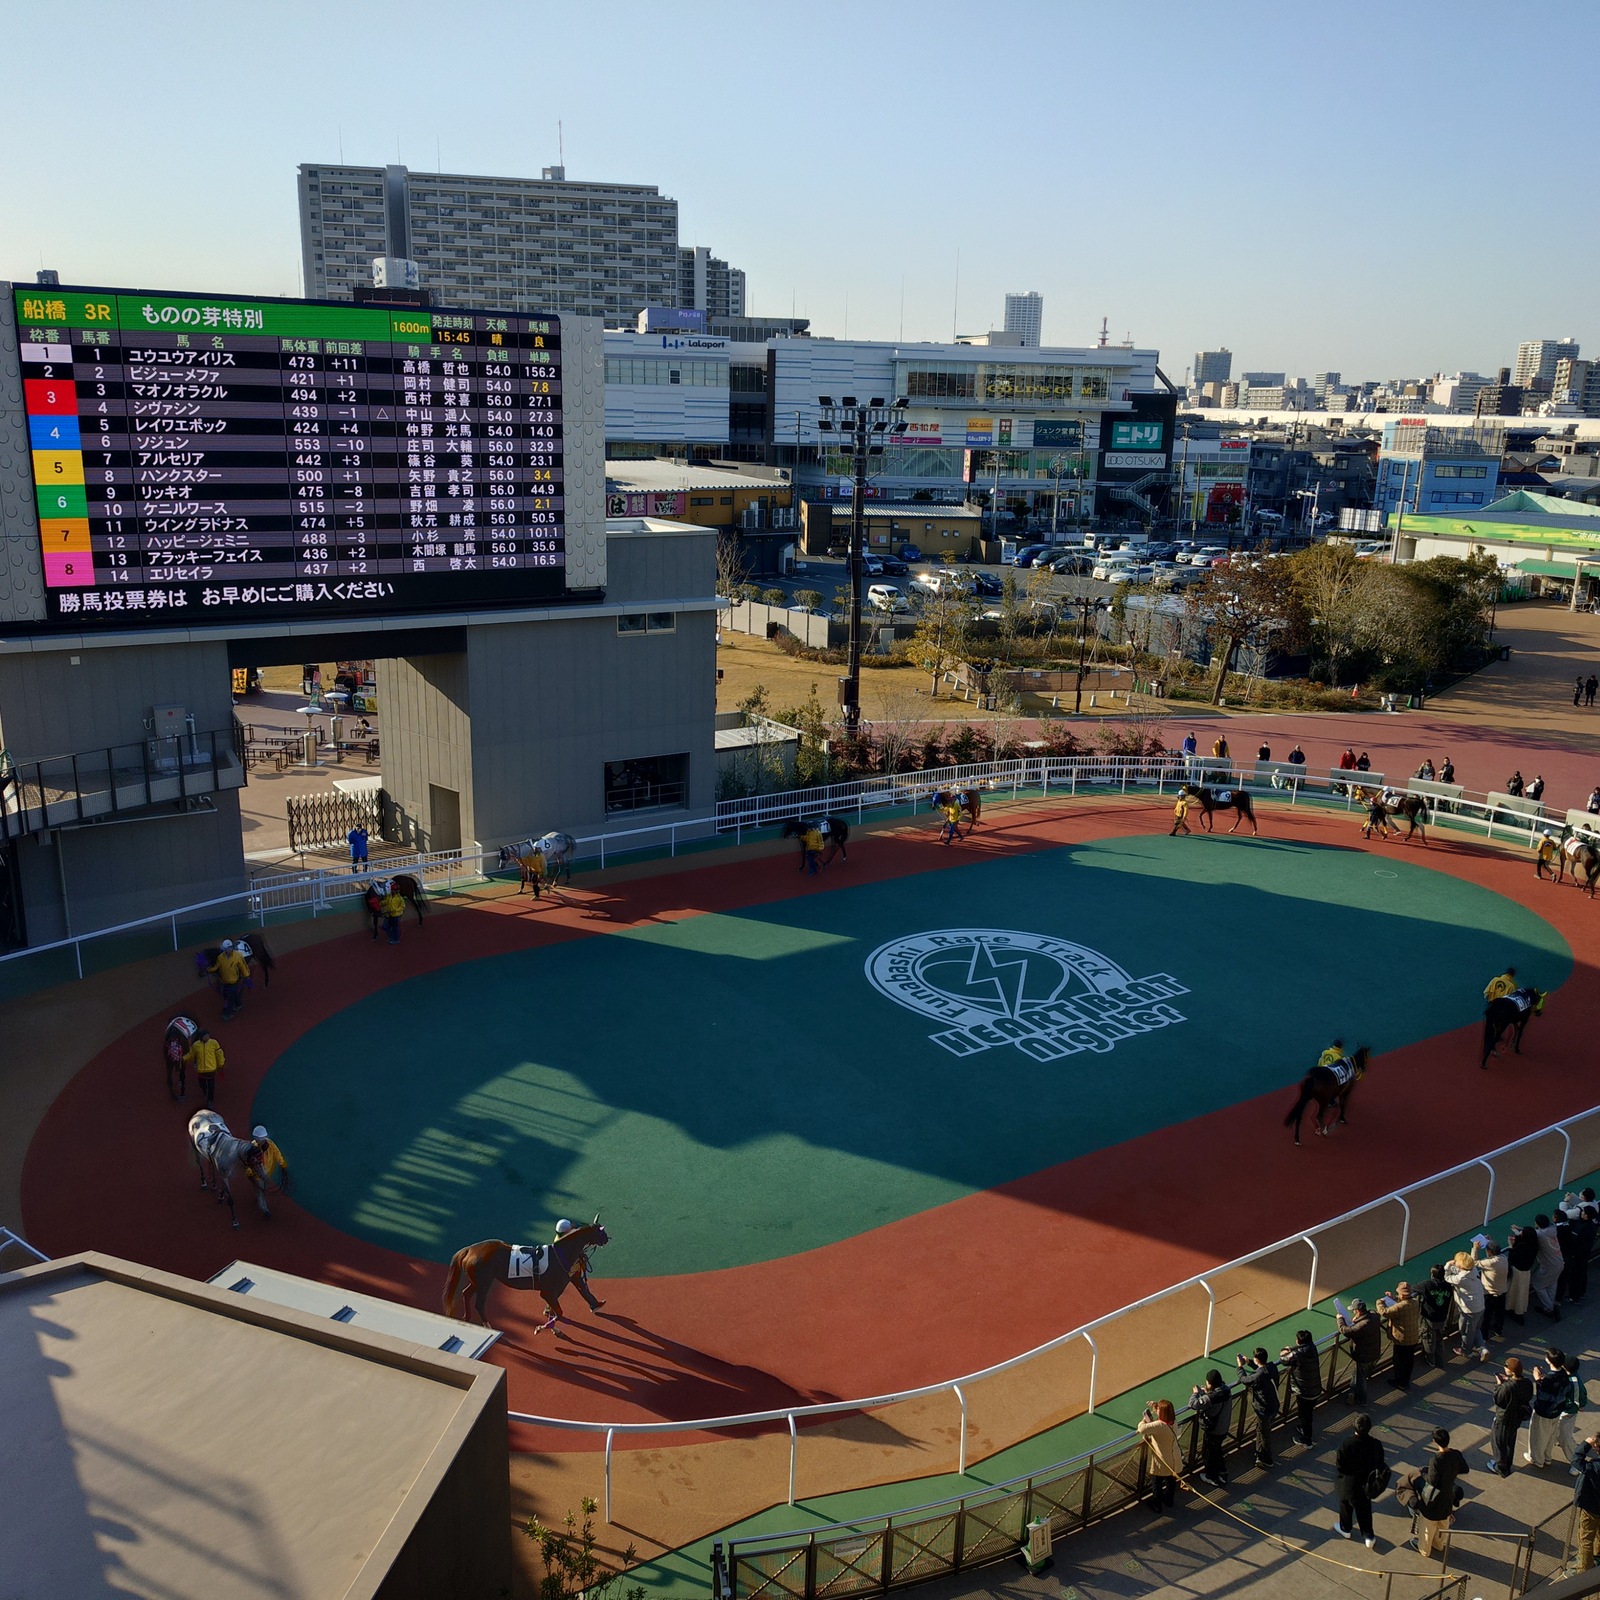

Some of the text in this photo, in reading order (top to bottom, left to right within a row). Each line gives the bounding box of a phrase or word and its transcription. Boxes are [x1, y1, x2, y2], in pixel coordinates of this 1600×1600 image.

[24, 299, 110, 320] 船橋 3R
[142, 304, 262, 328] ものの芽特別
[433, 315, 472, 329] 発走時刻
[394, 322, 429, 333] 1600m
[486, 319, 507, 331] 天候
[528, 321, 549, 333] 馬場
[438, 332, 469, 342] 15:45
[492, 334, 502, 345] 晴
[535, 336, 544, 347] 良
[30, 329, 59, 342] 枠番
[83, 331, 110, 344] 馬番
[282, 340, 319, 352] 馬体重
[326, 342, 362, 354] 前回差
[487, 349, 508, 361] 負担
[529, 352, 550, 363] 単勝
[688, 340, 725, 349] LaLaport
[43, 347, 48, 358] 1
[94, 349, 555, 377] 1 ユウユウアイリス 473 +11 高橋 哲也 54.0 156.2
[44, 366, 53, 377] 2
[95, 366, 548, 392] 2 ビジューメファ 421 +1 岡村 健司 54.0 7.8
[97, 384, 550, 406] 3 マオノオラクル 494 +2 西村 栄喜 56.0 27.1
[987, 384, 1050, 394] GOLD'S
[47, 392, 55, 403] 3
[99, 402, 107, 413] 4
[134, 401, 200, 415] シヴァシン
[293, 406, 317, 417] 439
[406, 408, 432, 420] 中山
[488, 411, 512, 421] 54.0
[530, 412, 552, 422] 27.3
[51, 428, 60, 438] 4
[101, 419, 553, 437] 5 レイワエポック 424 +4 仲野 光馬 54.0 14.0
[909, 423, 940, 432] 西松屋
[1036, 426, 1082, 435] ジュンク堂書店
[1116, 426, 1159, 445] ニトリ
[102, 436, 553, 452] 6 ソジュン 553 庄司 大輔 56.0 32.9
[103, 454, 111, 464] 7
[139, 453, 204, 465] アルセリア
[296, 455, 321, 465] 442
[343, 455, 360, 465] +3
[490, 456, 513, 465] 54.0
[531, 456, 552, 465] 23.1
[1125, 455, 1164, 466] OTSUKA
[55, 462, 63, 473] 5
[105, 469, 550, 482] 8 ハンクスター 500 +1 矢野 貴之 56.0 3.4
[107, 485, 554, 499] 9 リッキオ 475 吉留 孝司 56.0 44.9
[58, 496, 66, 507] 6
[105, 504, 122, 515] 10
[144, 503, 227, 515] ケニルワース
[300, 502, 324, 512] 515
[411, 500, 437, 512] 野畑
[491, 500, 514, 509] 56.0
[535, 499, 549, 508] 2.1
[106, 513, 554, 532] 11 ウイングラドナス 474 +5 秋元 耕成 56.0 50.5
[62, 530, 69, 541] 7
[108, 527, 557, 549] 12 ハッピージェミニ 488 小杉 亮 54.0 101.1
[110, 541, 555, 565] 13 アラッキーフェイス 436 +2 木間塚 龍馬 56.0 35.6
[65, 564, 73, 575] 8
[111, 570, 128, 581] 14
[150, 567, 212, 580] エリセイラ
[304, 564, 328, 574] 437
[349, 563, 366, 572] +2
[413, 560, 424, 571] 西
[493, 557, 516, 567] 54.0
[534, 555, 555, 565] 16.5
[60, 582, 393, 612] 勝馬投票券は お早めにご購入ください
[884, 933, 1113, 1019] Funabashi Race Track
